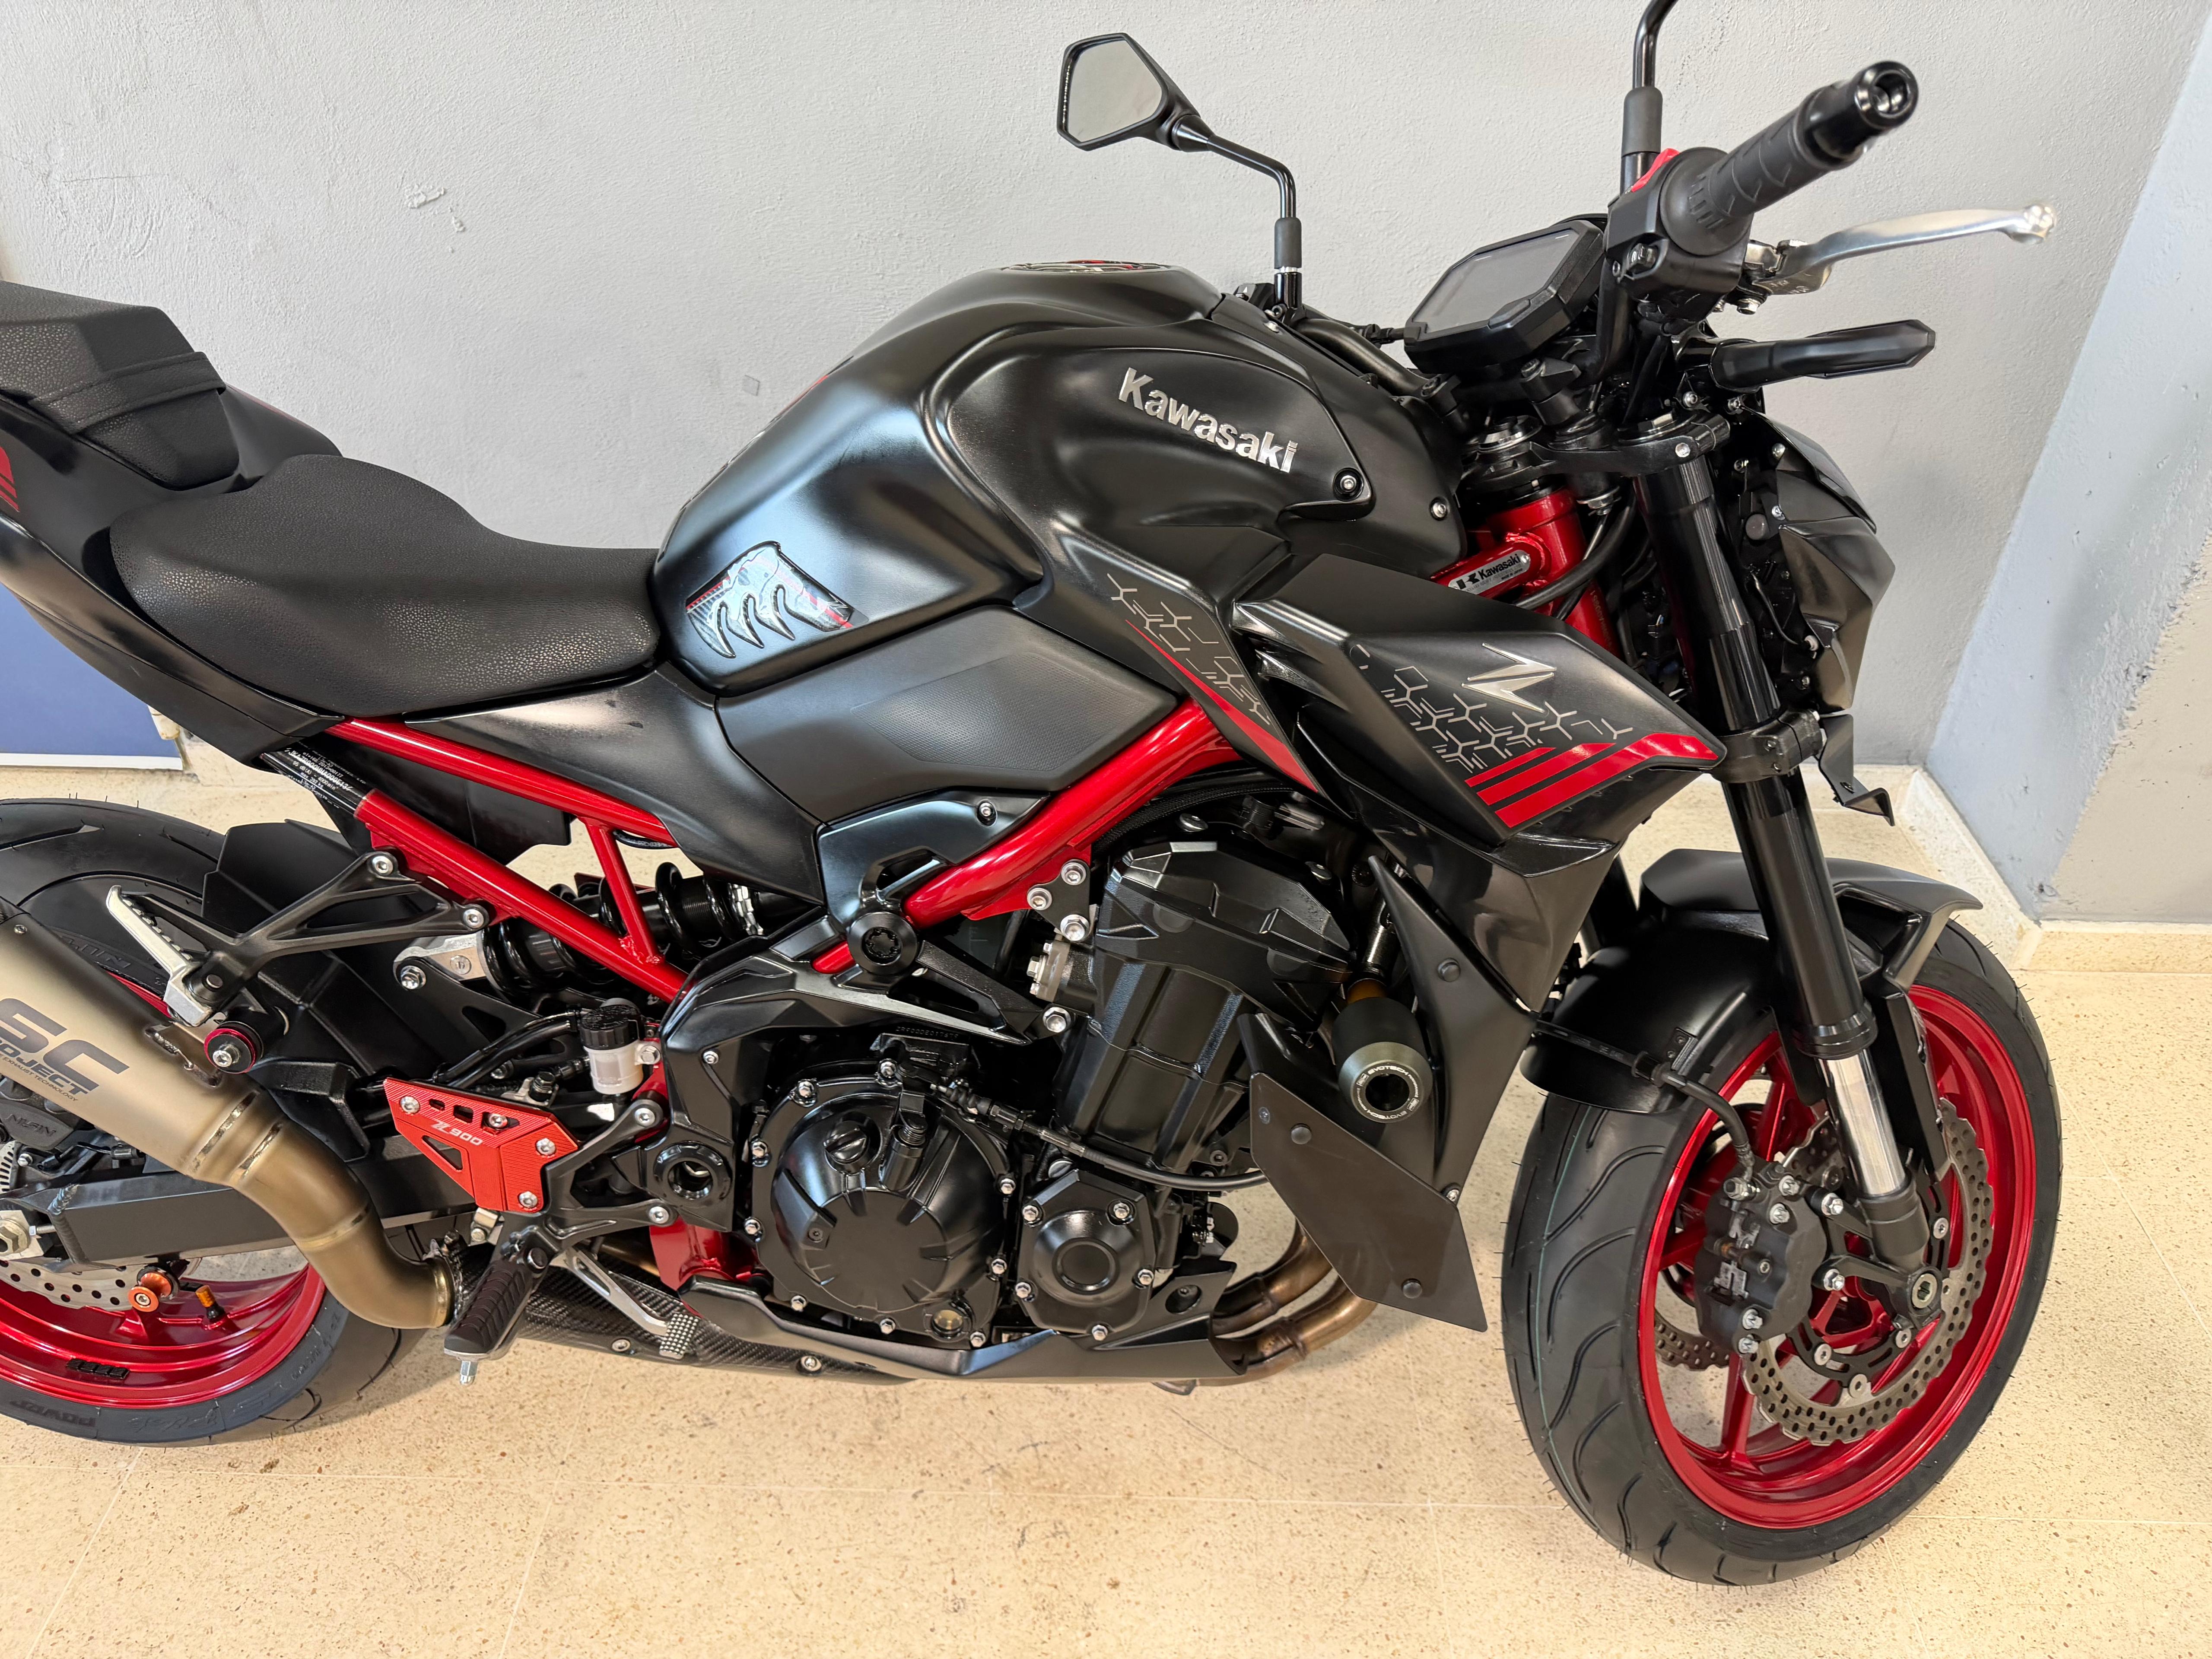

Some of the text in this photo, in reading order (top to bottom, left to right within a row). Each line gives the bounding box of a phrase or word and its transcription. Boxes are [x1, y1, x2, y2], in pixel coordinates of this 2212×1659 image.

[1118, 367, 1299, 474] Kawasaki
[1478, 553, 1521, 580] Kawasaki
[0, 998, 130, 1092] SC
[0, 1039, 89, 1095] OJECT
[3, 1057, 78, 1102] EXHAUST TECHNOLOGY
[1367, 1065, 1409, 1075] EVOTECH
[1367, 1109, 1408, 1120] EVOTECH
